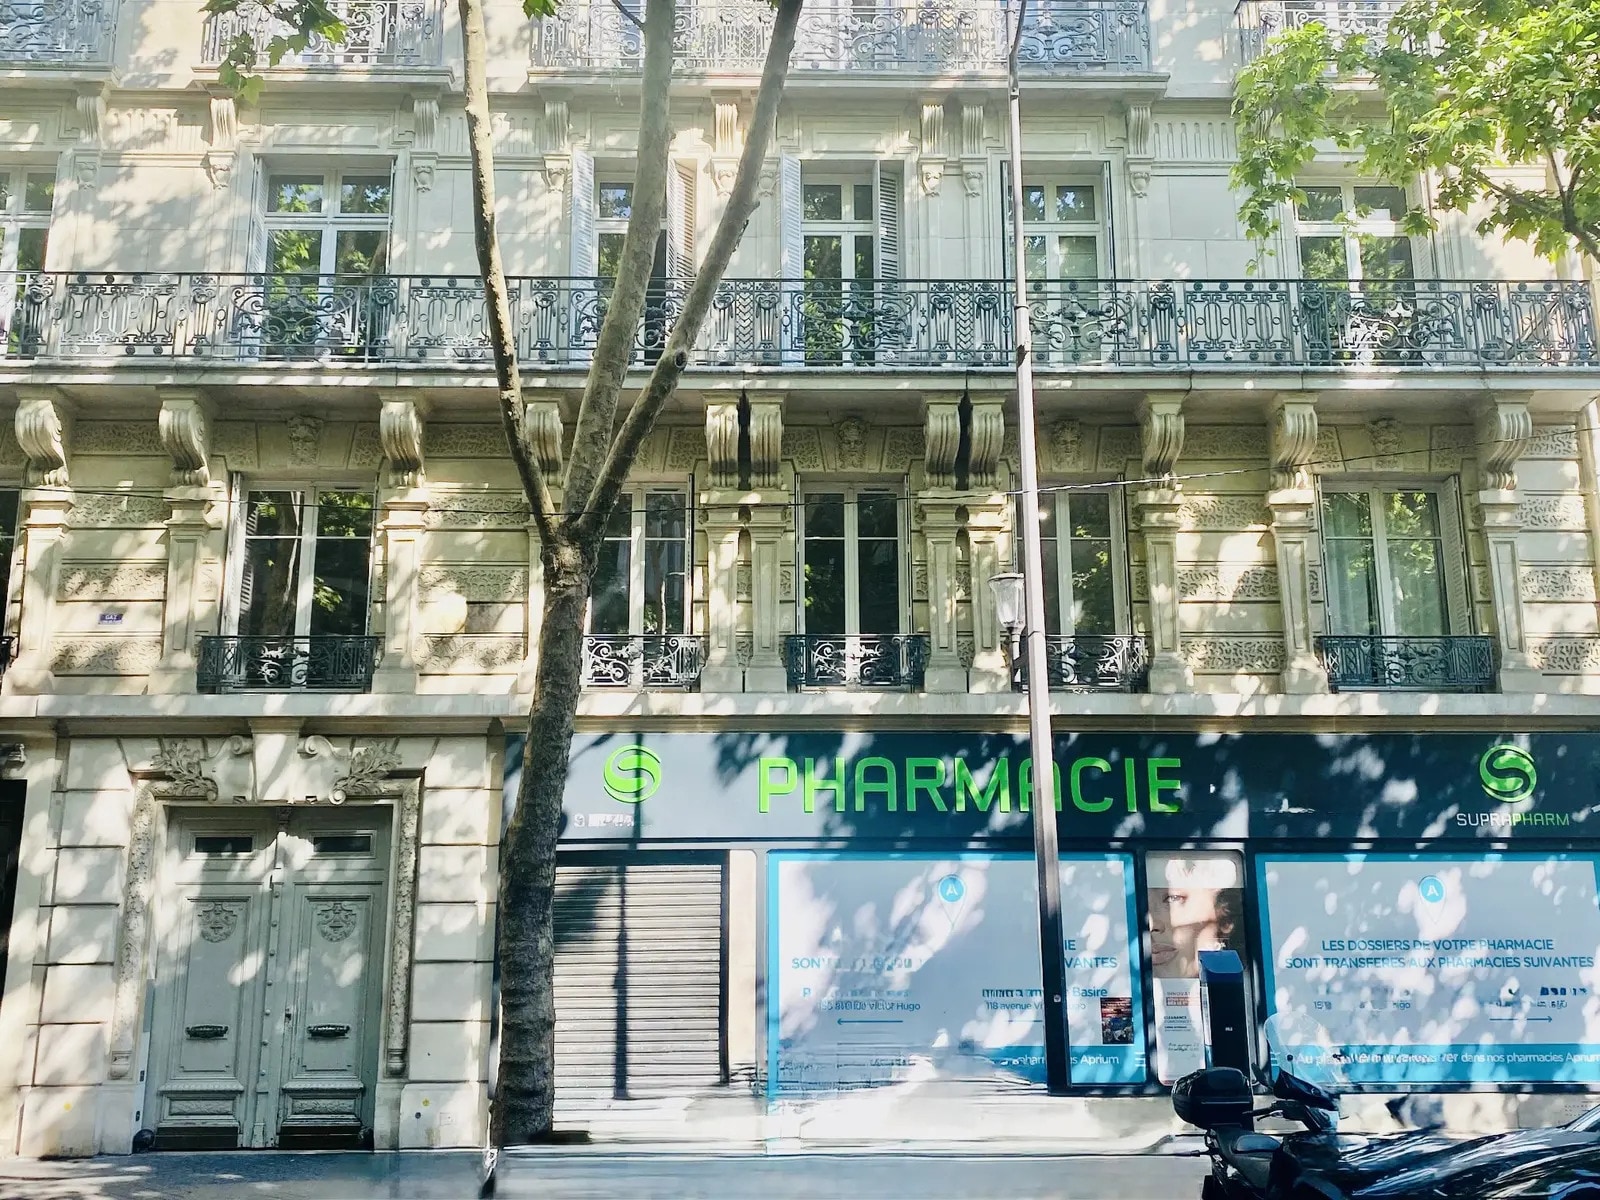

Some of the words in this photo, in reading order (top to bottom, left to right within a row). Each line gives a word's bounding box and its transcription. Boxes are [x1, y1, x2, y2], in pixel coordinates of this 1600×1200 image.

[758, 756, 1182, 813] PHARMACIE
[1456, 813, 1570, 826] SUPRAPHARM
[1321, 940, 1345, 951] LES
[1347, 940, 1411, 951] DOSSIERS
[1412, 940, 1431, 951] DE
[1432, 939, 1476, 951] VOTRE
[1479, 939, 1555, 951] PHARMACIE
[1285, 957, 1320, 969] SONT
[1323, 957, 1406, 969] TRANSFERES
[1408, 957, 1436, 968] AUX
[1438, 957, 1521, 968] PHARMACIES
[1523, 956, 1595, 968] SUIVANTES
[1072, 986, 1108, 998] Basire
[896, 1002, 921, 1012] Hugo
[985, 1002, 998, 1010] 118
[1080, 1053, 1120, 1066] Aprium
[1461, 1052, 1486, 1063] dans
[1487, 1053, 1505, 1063] nos
[1507, 1052, 1564, 1064] pharmacies
